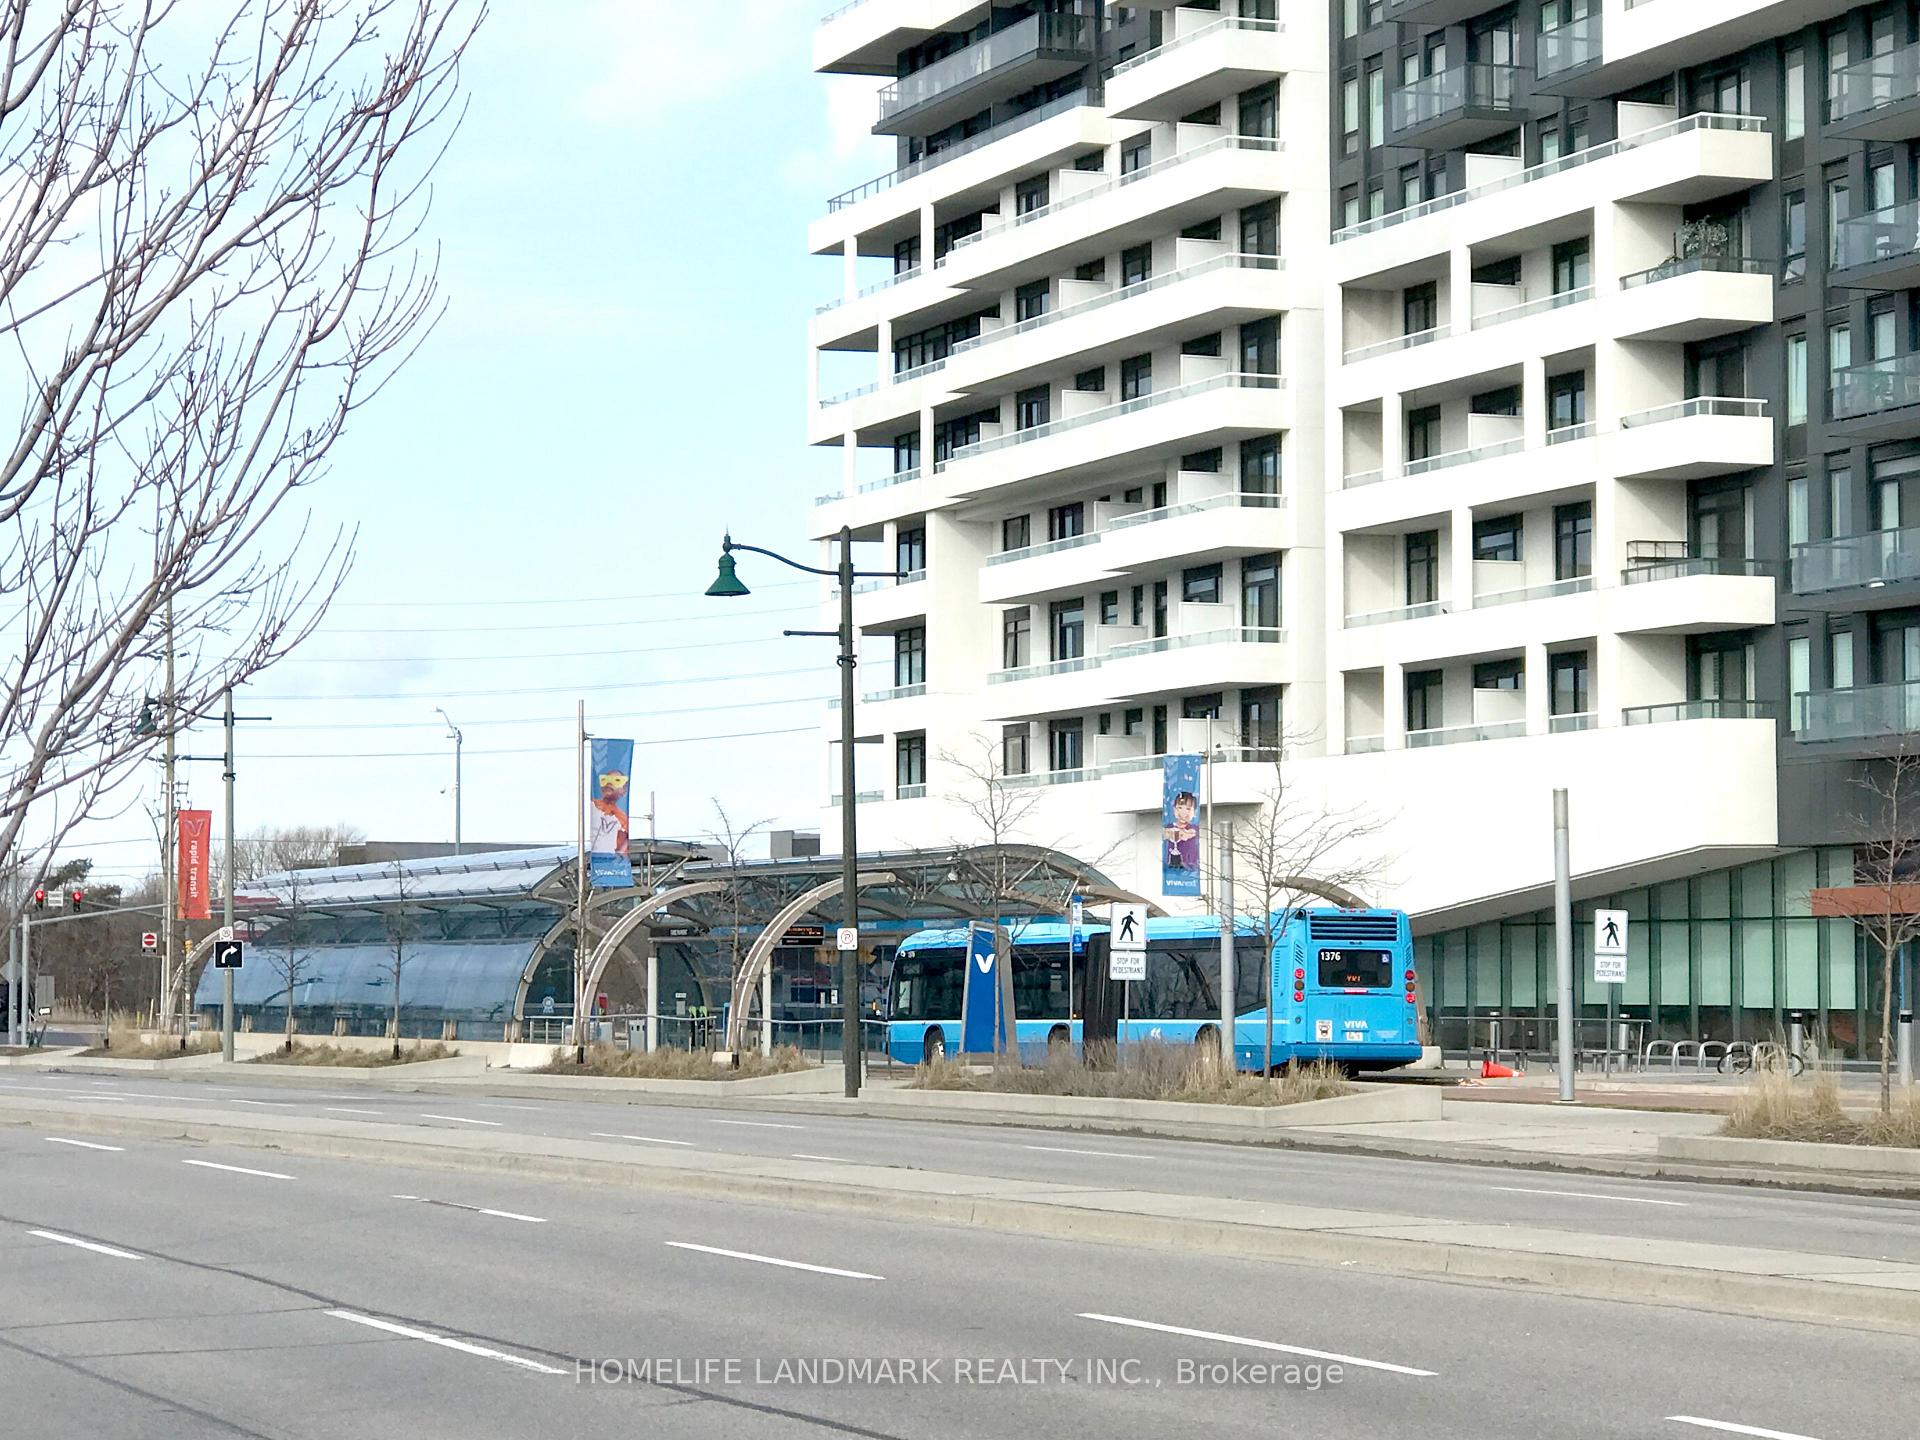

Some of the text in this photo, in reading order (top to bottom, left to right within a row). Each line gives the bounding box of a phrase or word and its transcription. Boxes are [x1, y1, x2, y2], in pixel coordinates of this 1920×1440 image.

[189, 840, 199, 898] rapid transit
[1320, 951, 1341, 961] 1376
[974, 953, 996, 974] V
[1116, 957, 1140, 965] STOP FOR
[1112, 966, 1144, 974] PEDESTRIANS
[1343, 1020, 1369, 1029] VIVA
